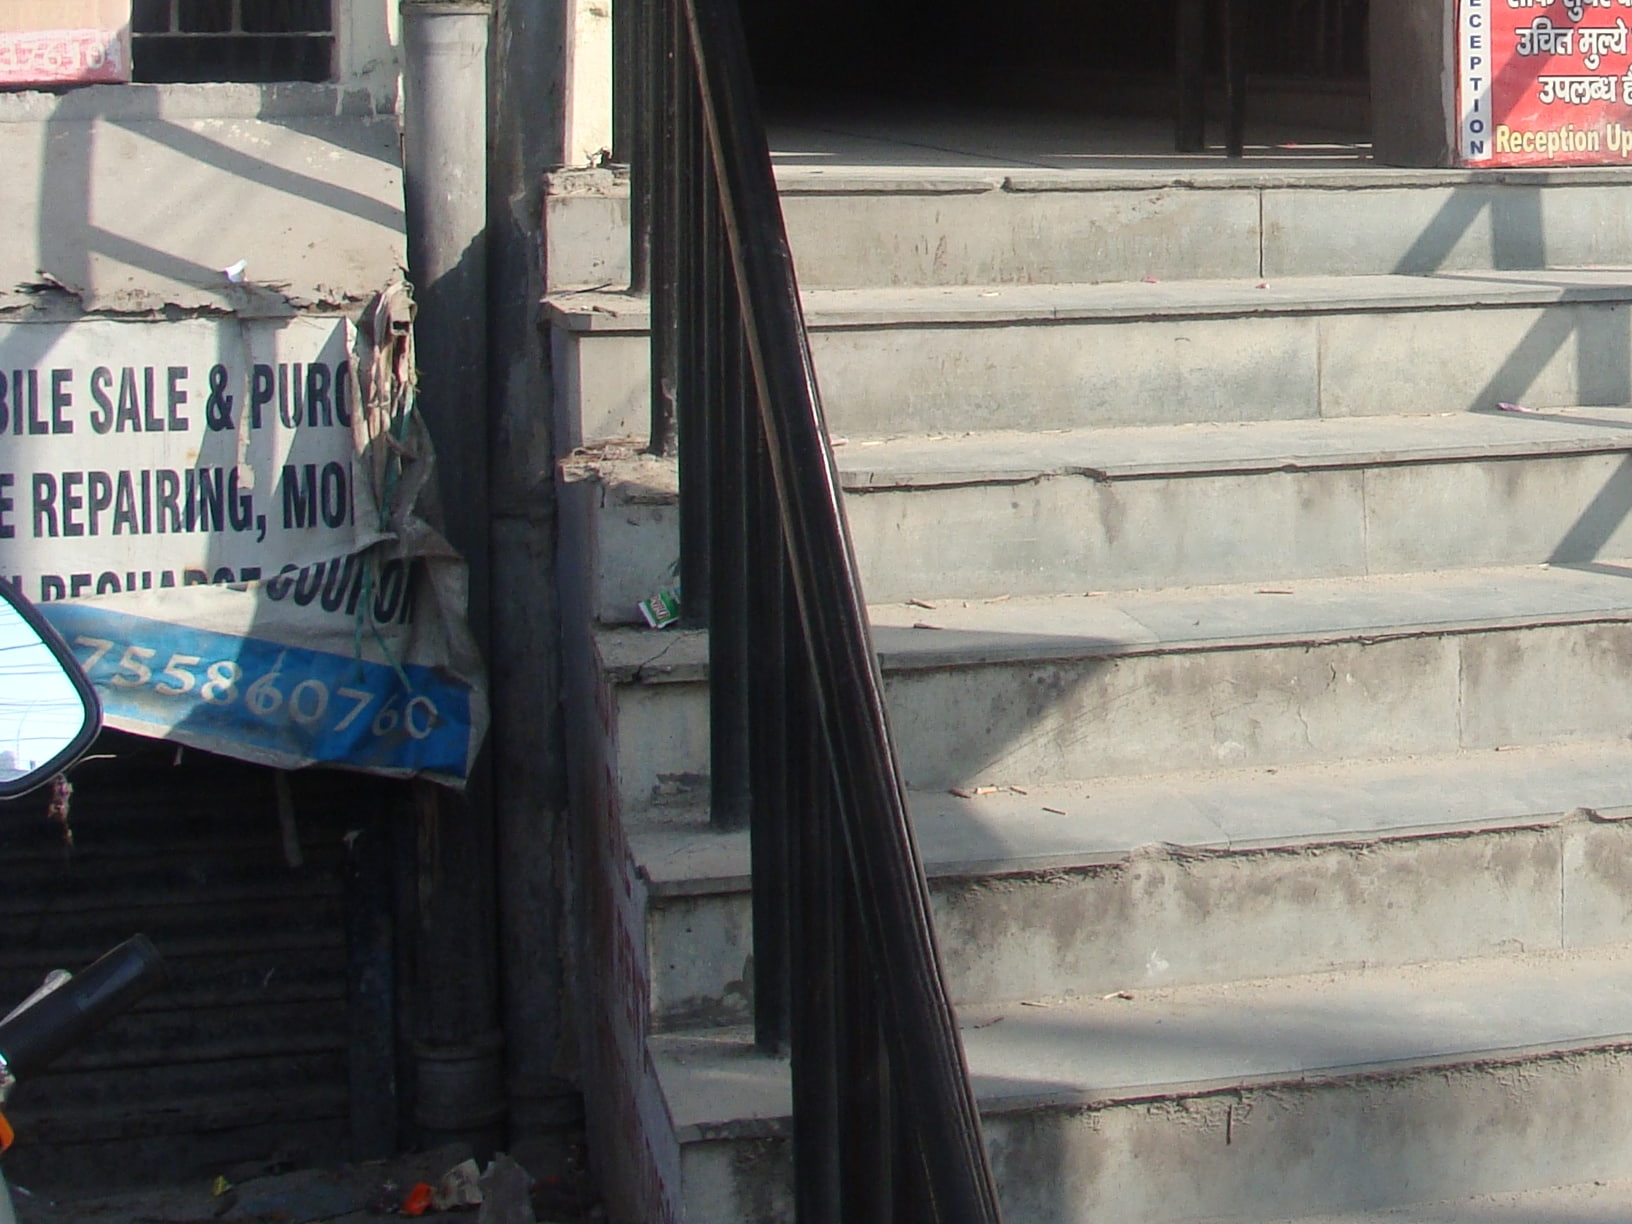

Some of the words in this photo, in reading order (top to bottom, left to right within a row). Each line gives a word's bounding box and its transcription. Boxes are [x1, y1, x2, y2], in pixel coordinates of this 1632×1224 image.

[1515, 16, 1573, 56] उचित
[1538, 74, 1617, 105] उपलब्ध
[1496, 123, 1600, 158] Reception
[90, 366, 190, 435] SALE
[206, 363, 235, 432] &
[32, 464, 267, 543] REPAIRING,
[283, 461, 355, 529] MO
